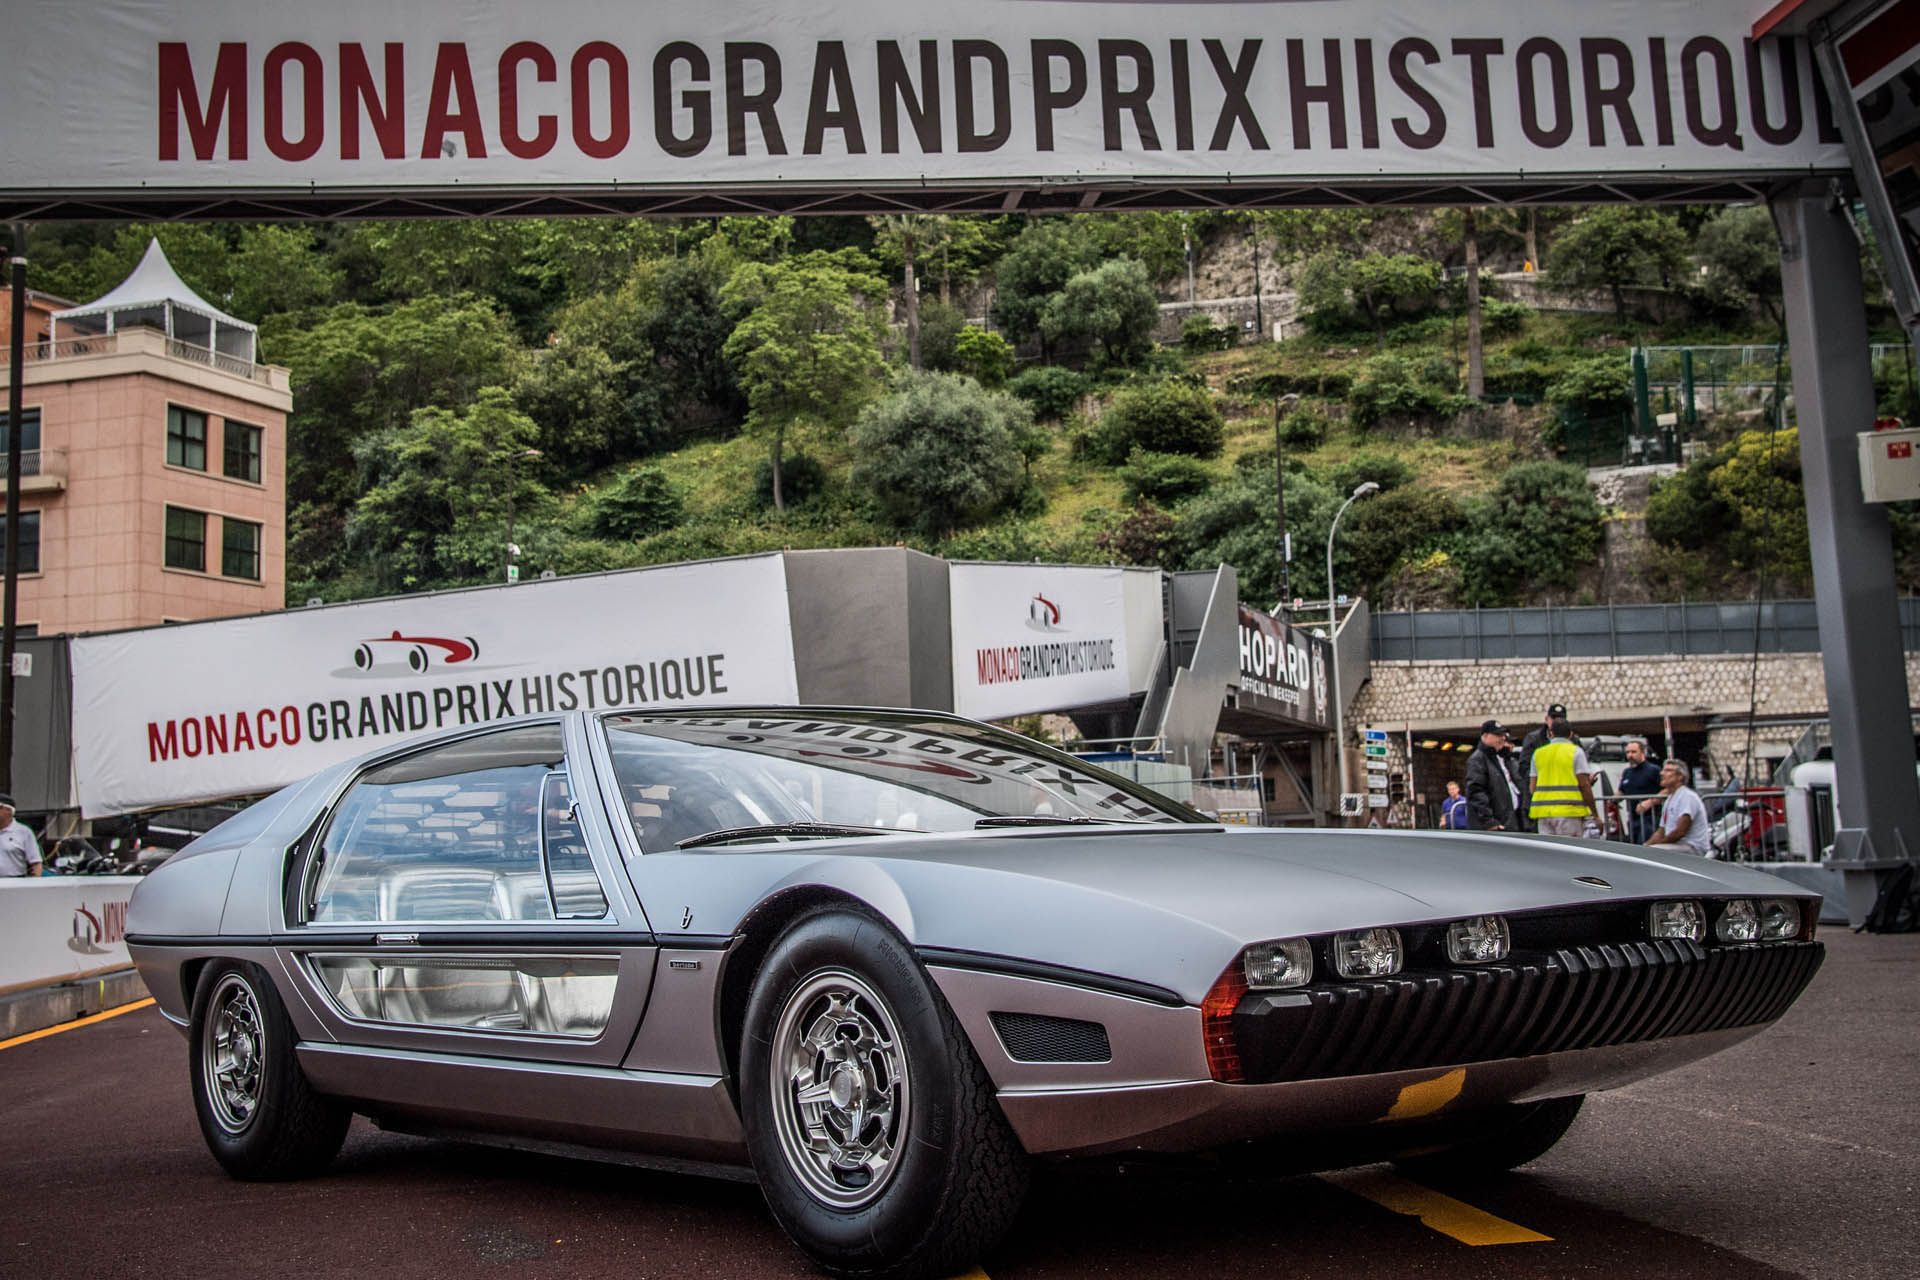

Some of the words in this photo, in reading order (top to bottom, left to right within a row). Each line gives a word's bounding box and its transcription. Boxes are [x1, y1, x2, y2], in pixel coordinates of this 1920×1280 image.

[158, 41, 630, 161] MONACO
[653, 39, 1011, 158] GRAND
[1031, 38, 1270, 152] PRIX
[147, 705, 301, 763] MONACO
[307, 690, 428, 743] GRAND
[433, 679, 516, 728] PRIX
[521, 653, 728, 714] HISTORIQUE
[977, 646, 1019, 685] MONACO
[1020, 643, 1050, 680] GRAND
[1050, 641, 1070, 676] PRIX
[1070, 638, 1115, 674] HISTORIQUE
